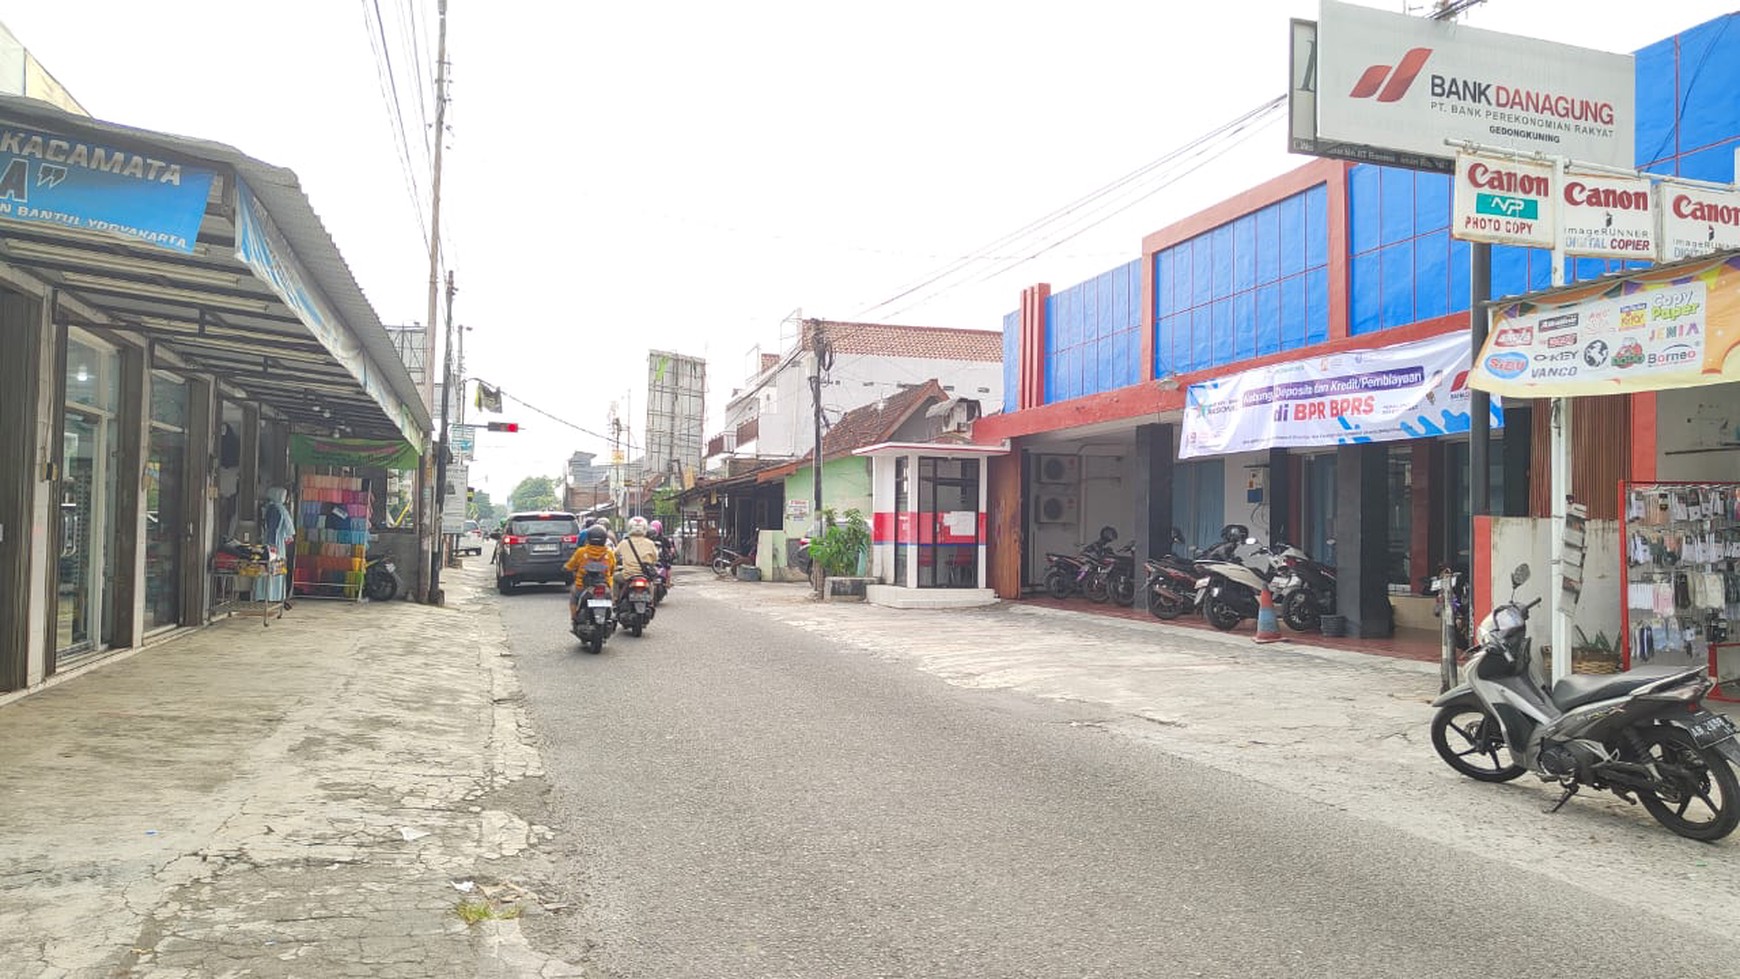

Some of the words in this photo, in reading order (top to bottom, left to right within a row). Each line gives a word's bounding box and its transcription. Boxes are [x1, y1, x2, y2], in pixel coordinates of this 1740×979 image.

[1431, 74, 1492, 107] BANK
[1495, 85, 1615, 126] DANAGUNG
[1430, 101, 1447, 113] PT.
[1451, 105, 1482, 119] BANK
[1485, 110, 1571, 132] PEREKONOMIAN
[1574, 124, 1615, 138] RAKYAT
[1489, 125, 1561, 144] GEDONGKUNING
[0, 130, 182, 187] KACAMATA
[1468, 163, 1549, 197] Canon
[1563, 181, 1649, 211] Canon
[17, 206, 81, 226] BANTUL
[1465, 216, 1501, 231] PHOTO
[1505, 220, 1533, 235] COPY
[1610, 238, 1650, 251] COPIER
[1654, 290, 1694, 307] Copy
[1651, 303, 1700, 321] Paper
[1649, 322, 1700, 342] JENIA
[1648, 349, 1697, 364] Borneo
[1531, 366, 1578, 378] VANCO
[1274, 403, 1289, 422] di
[1294, 401, 1326, 421] BPR
[1330, 395, 1375, 418] BPRS
